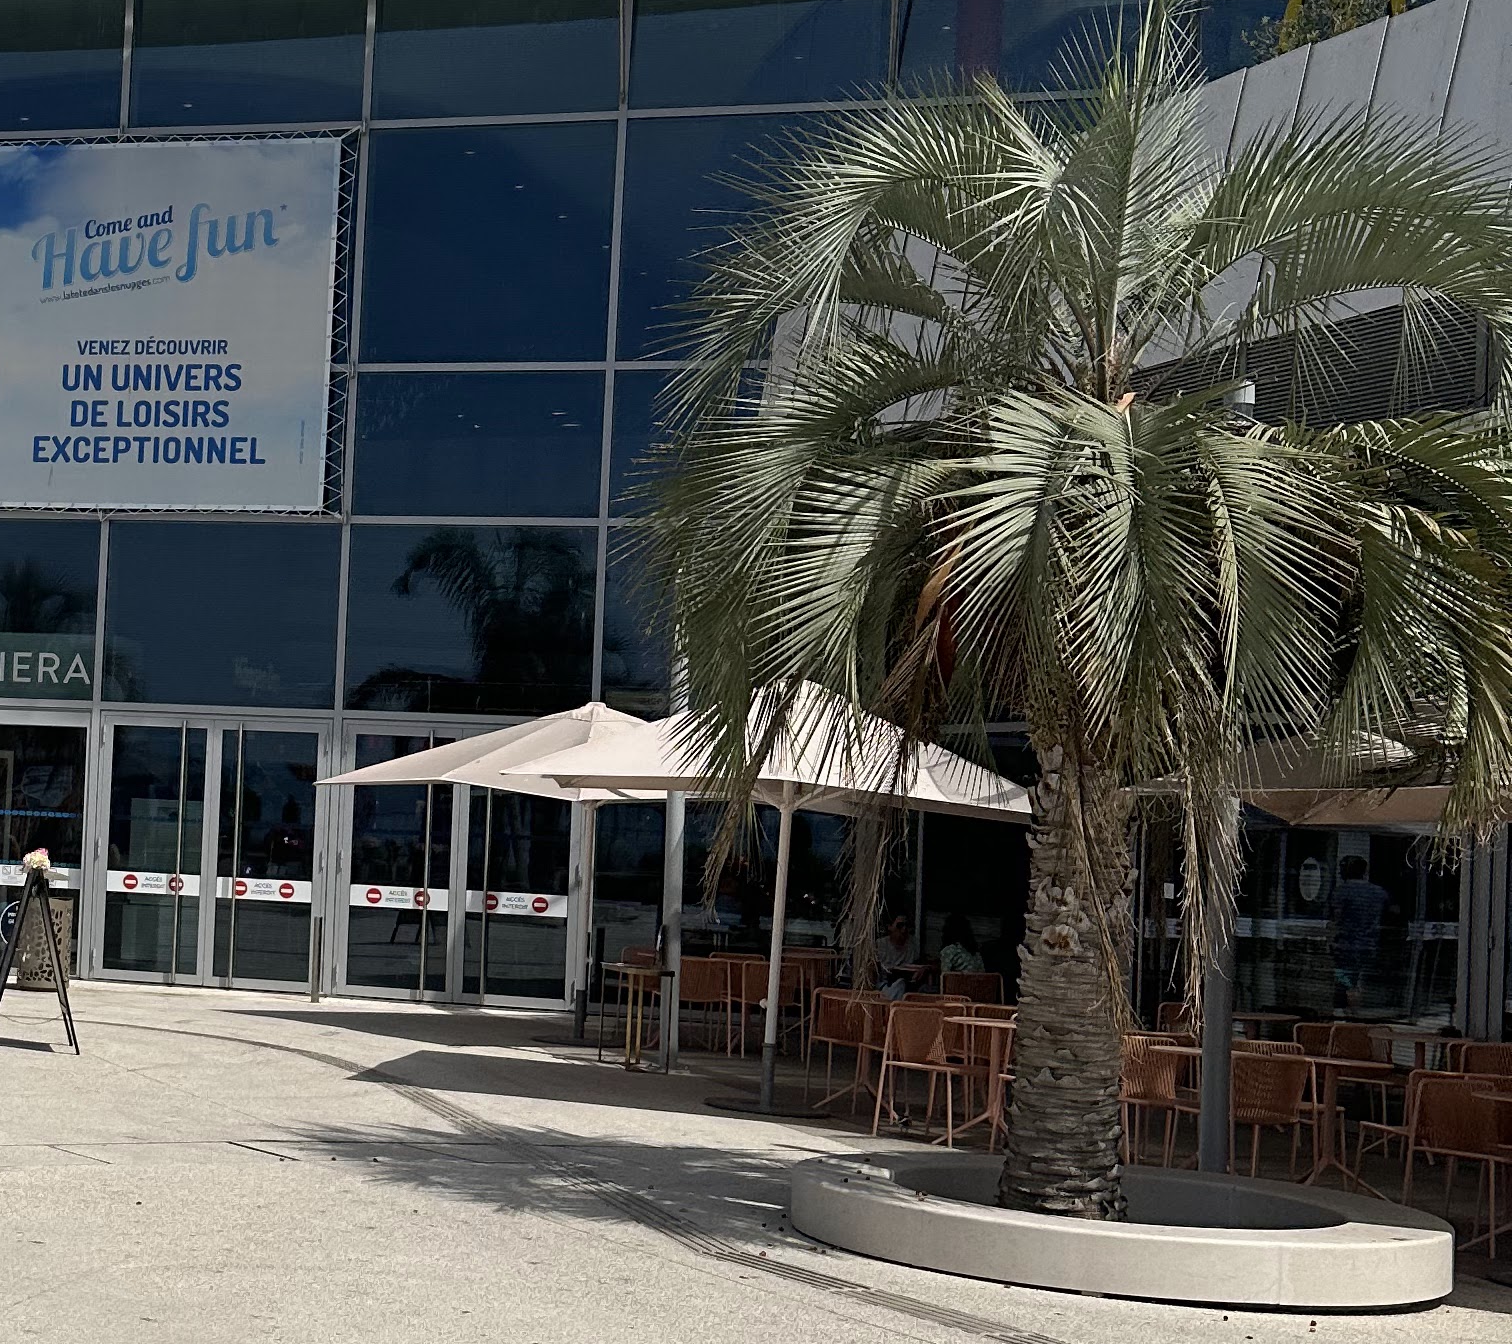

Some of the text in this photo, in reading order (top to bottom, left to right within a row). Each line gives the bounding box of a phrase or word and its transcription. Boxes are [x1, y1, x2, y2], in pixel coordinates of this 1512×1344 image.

[85, 205, 174, 240] Come and
[31, 226, 174, 291] Have
[76, 336, 229, 356] VENEZ DÉCOUVRIR
[61, 363, 242, 392] UN UNIVERS
[70, 400, 230, 428] DE LOISIRS
[32, 435, 266, 465] EXCEPTIONNEL
